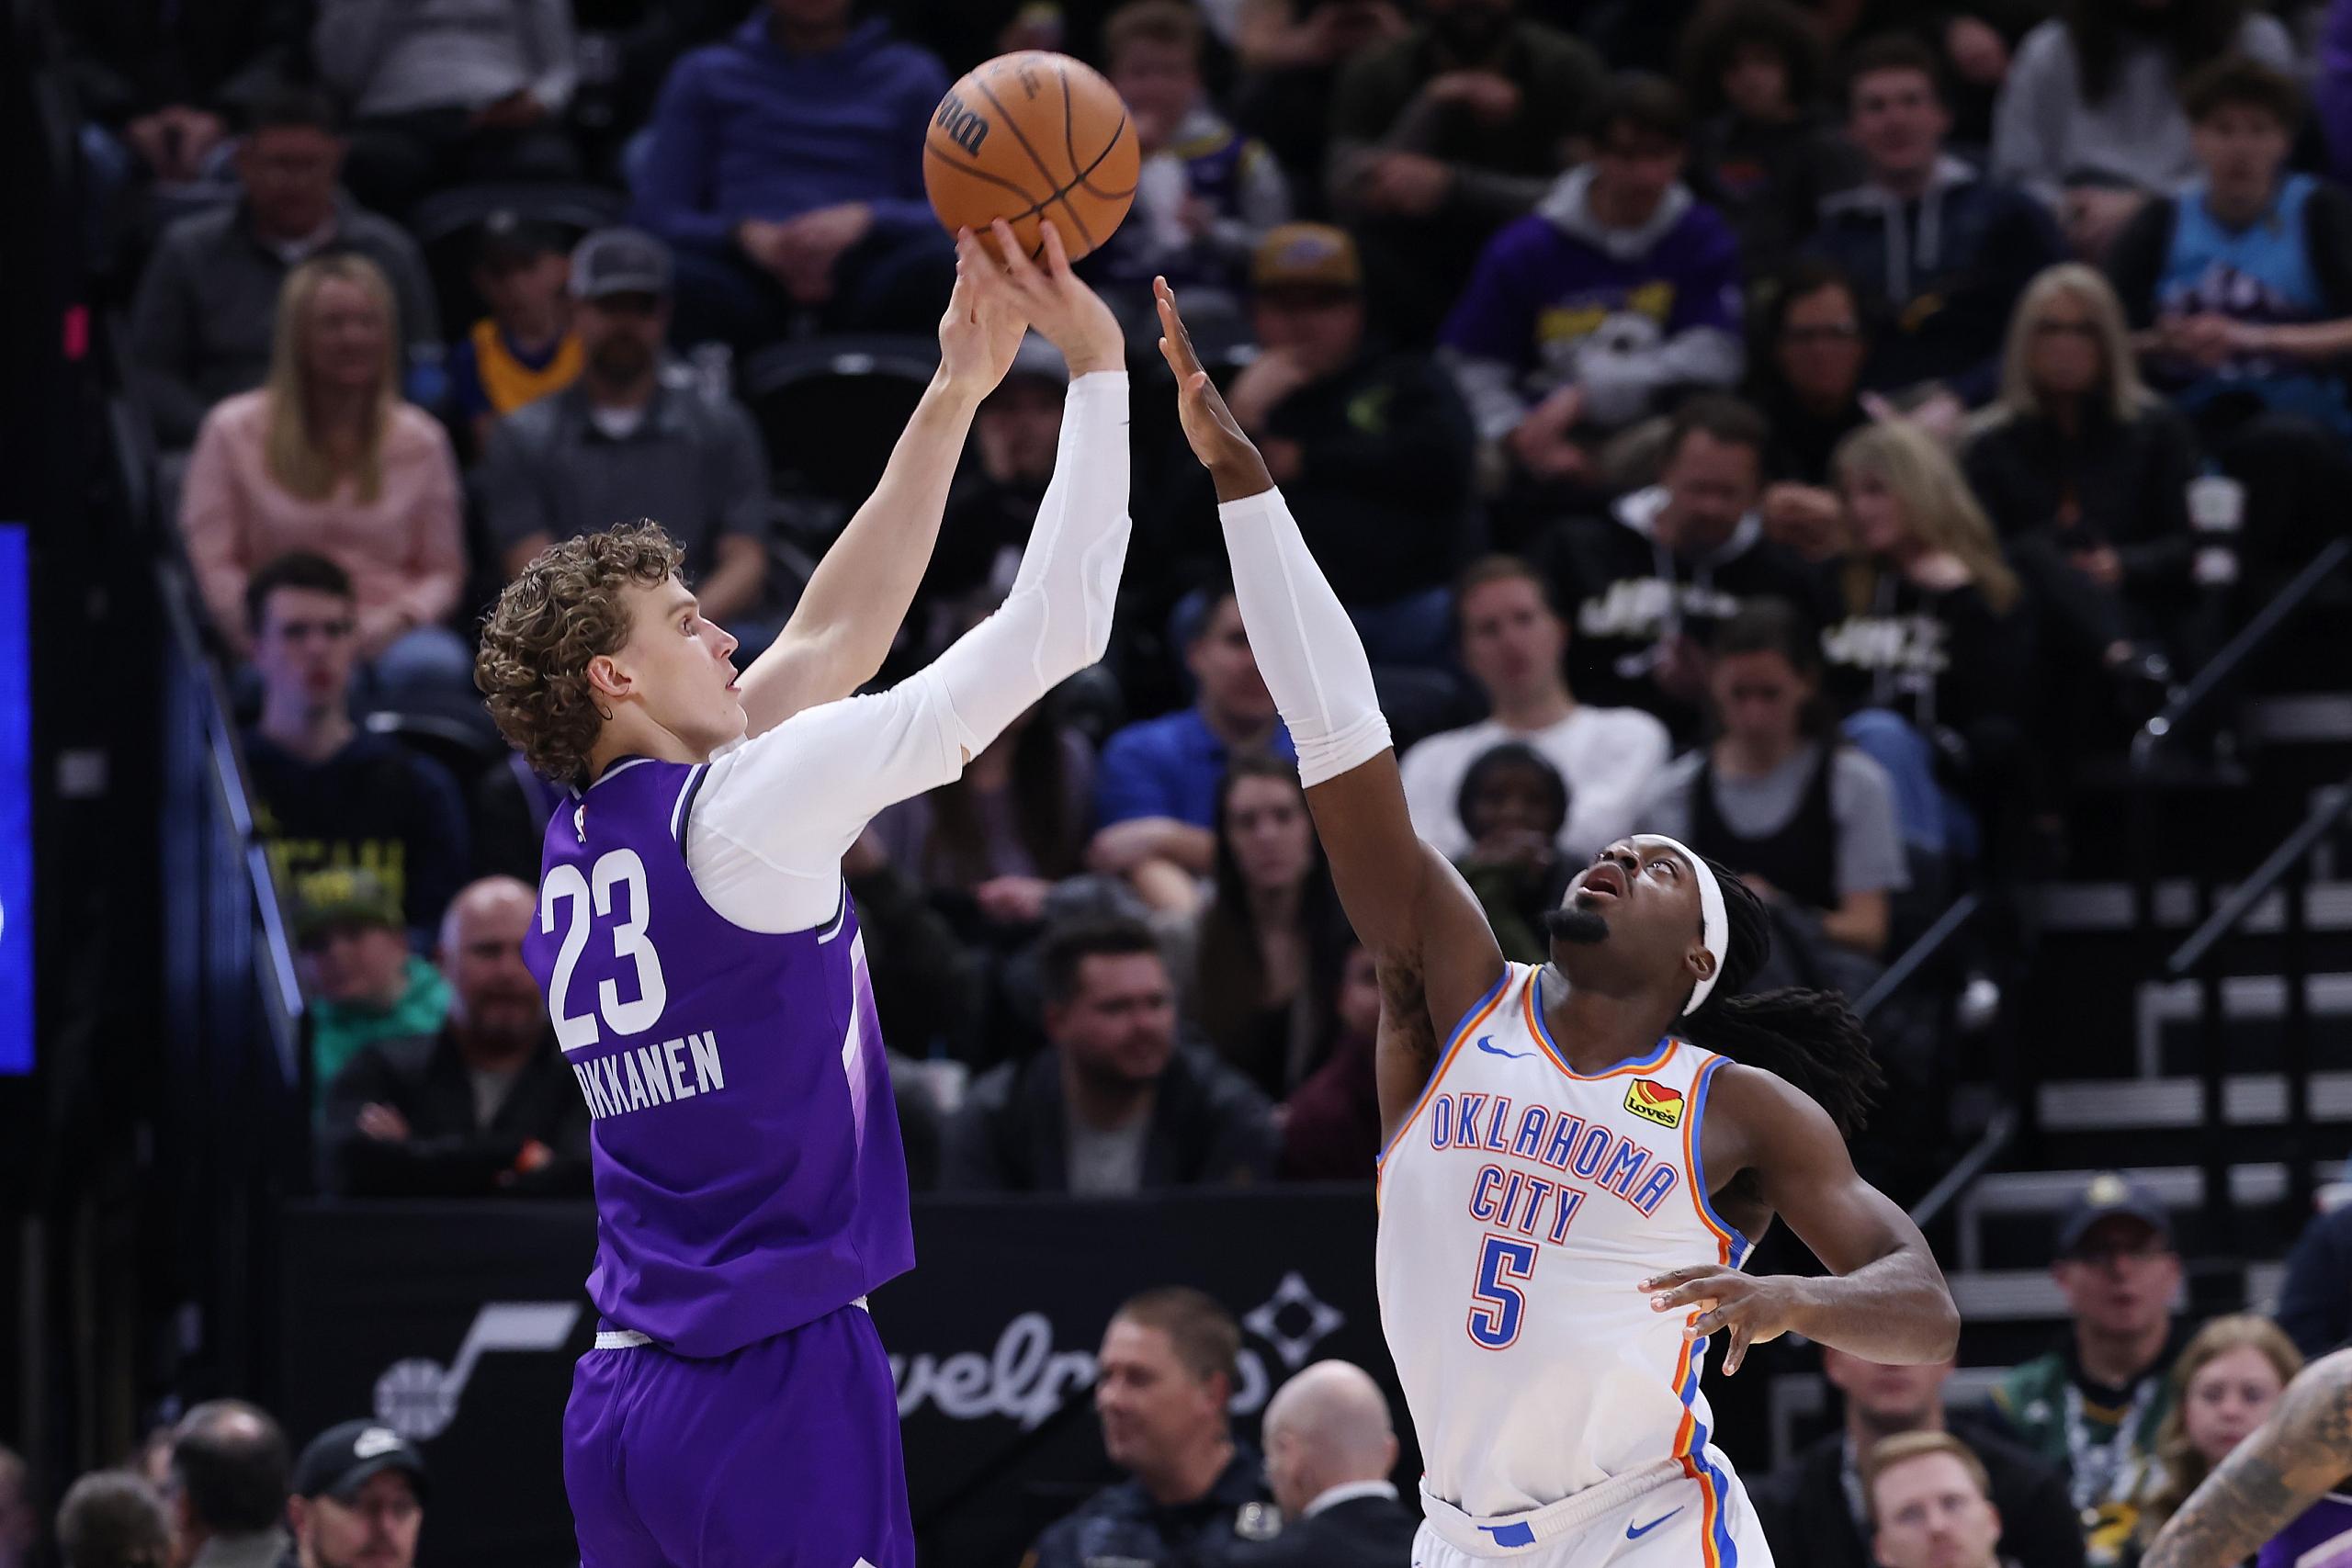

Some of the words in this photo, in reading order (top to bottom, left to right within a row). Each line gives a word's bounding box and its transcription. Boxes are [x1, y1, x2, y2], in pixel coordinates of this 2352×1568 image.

[541, 847, 667, 1054] 23
[571, 1029, 725, 1120] RKKANEN
[1430, 1092, 1679, 1219] OKLAHOMA
[1469, 1164, 1588, 1245] CITY
[1466, 1232, 1540, 1351] 5
